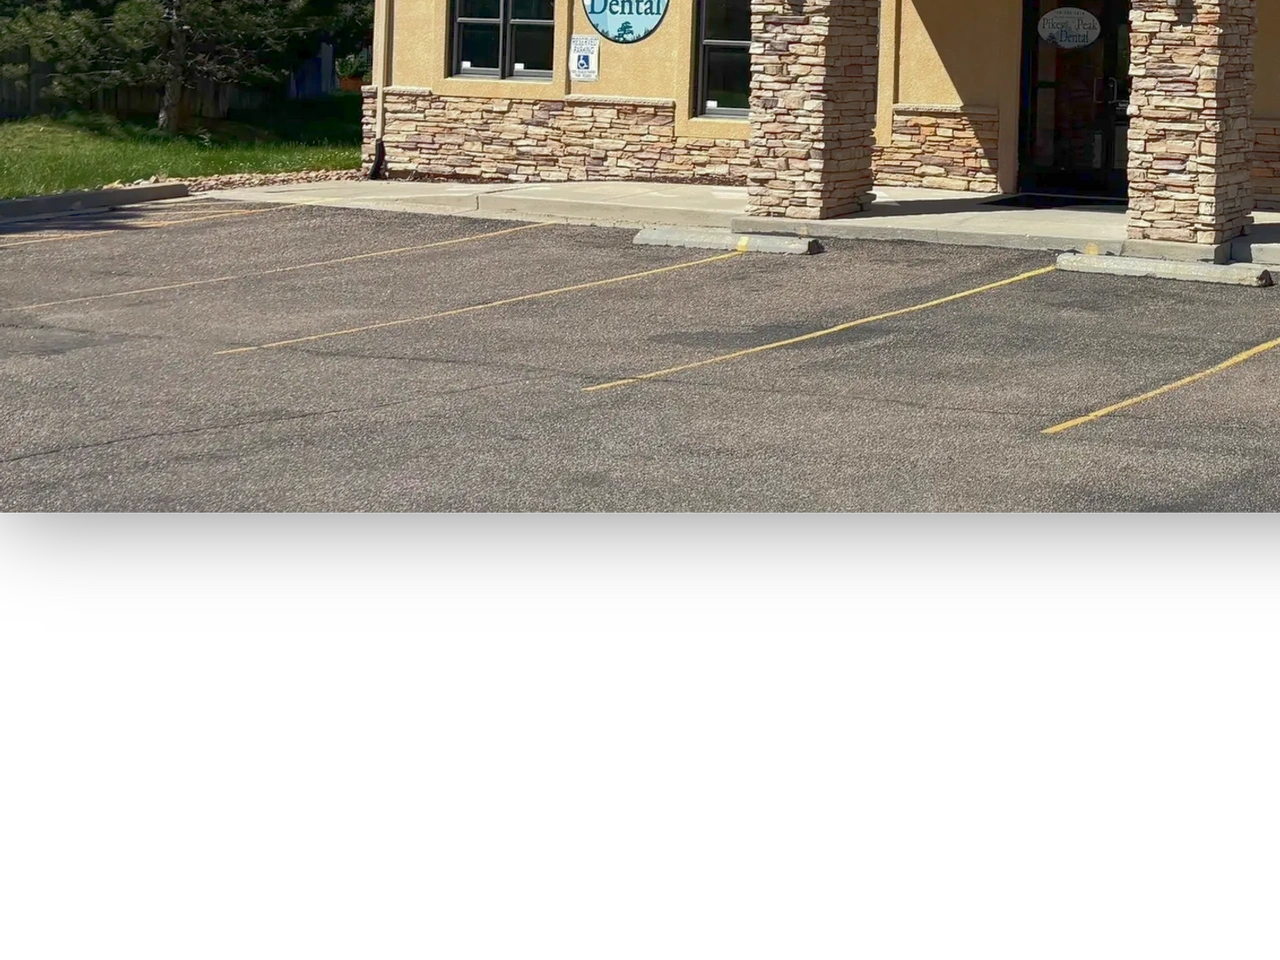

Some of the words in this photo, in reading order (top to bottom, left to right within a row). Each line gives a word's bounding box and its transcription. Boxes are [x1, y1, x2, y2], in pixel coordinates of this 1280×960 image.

[1042, 18, 1065, 30] Pikes
[1077, 18, 1098, 30] Peak
[1060, 30, 1089, 43] Dental
